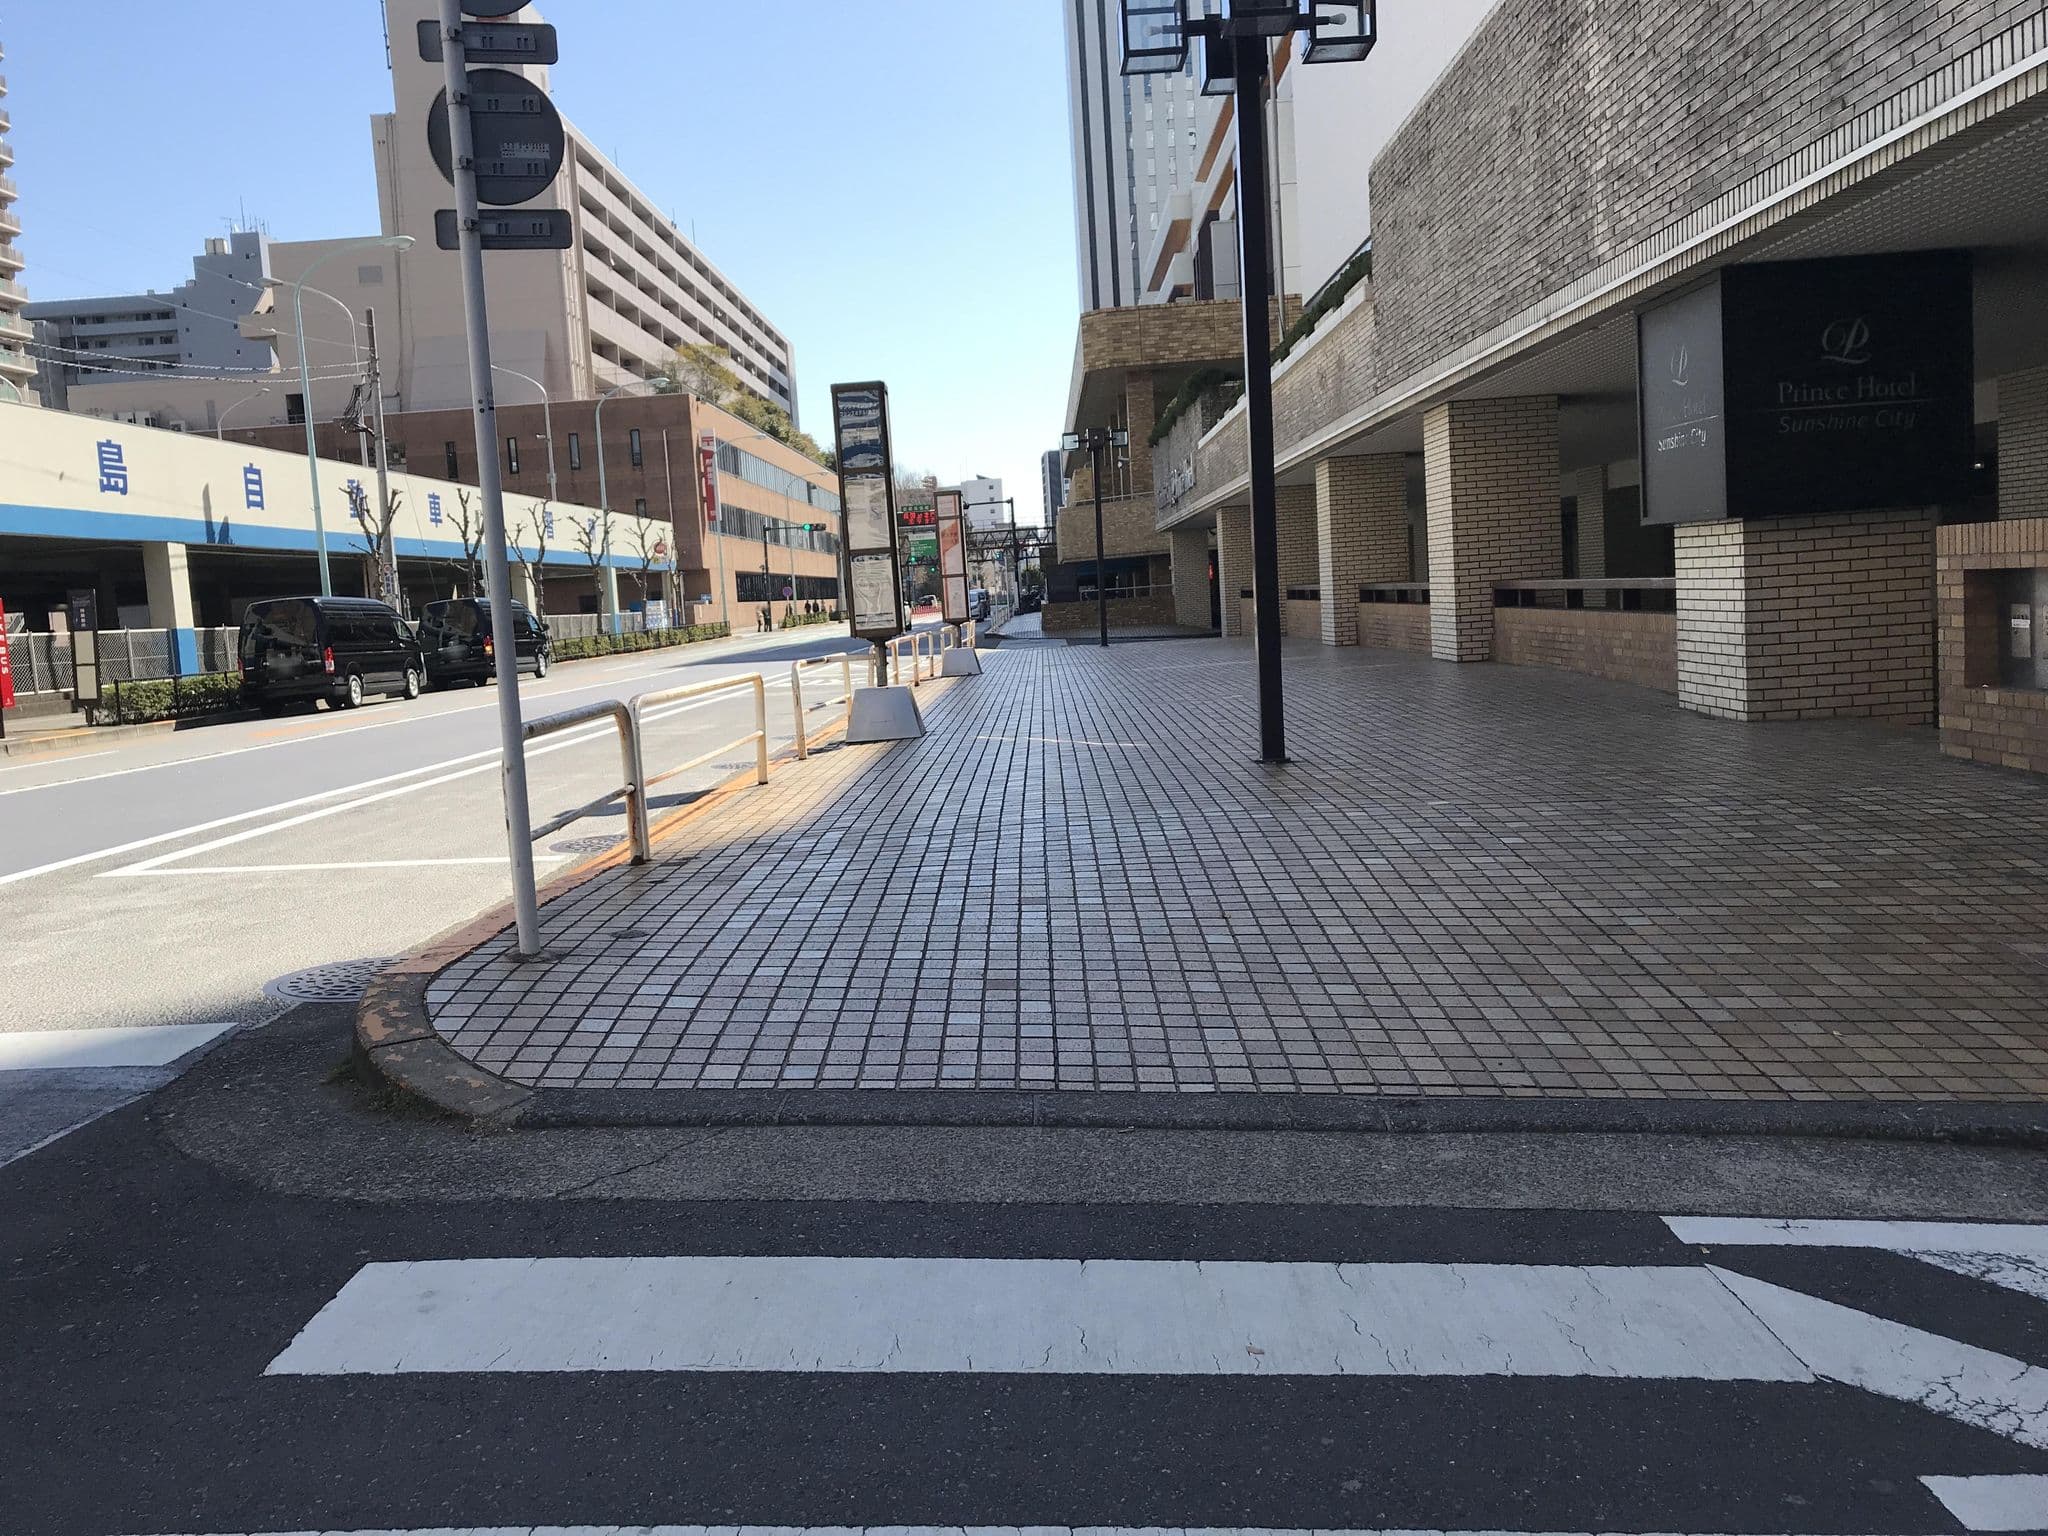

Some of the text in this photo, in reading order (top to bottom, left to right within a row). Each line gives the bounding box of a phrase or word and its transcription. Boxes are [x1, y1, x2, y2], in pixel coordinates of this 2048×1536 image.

[1777, 372, 1916, 404] Prince Hotel
[1778, 408, 1920, 434] Sunshine City
[1657, 431, 1689, 452] Sunshin
